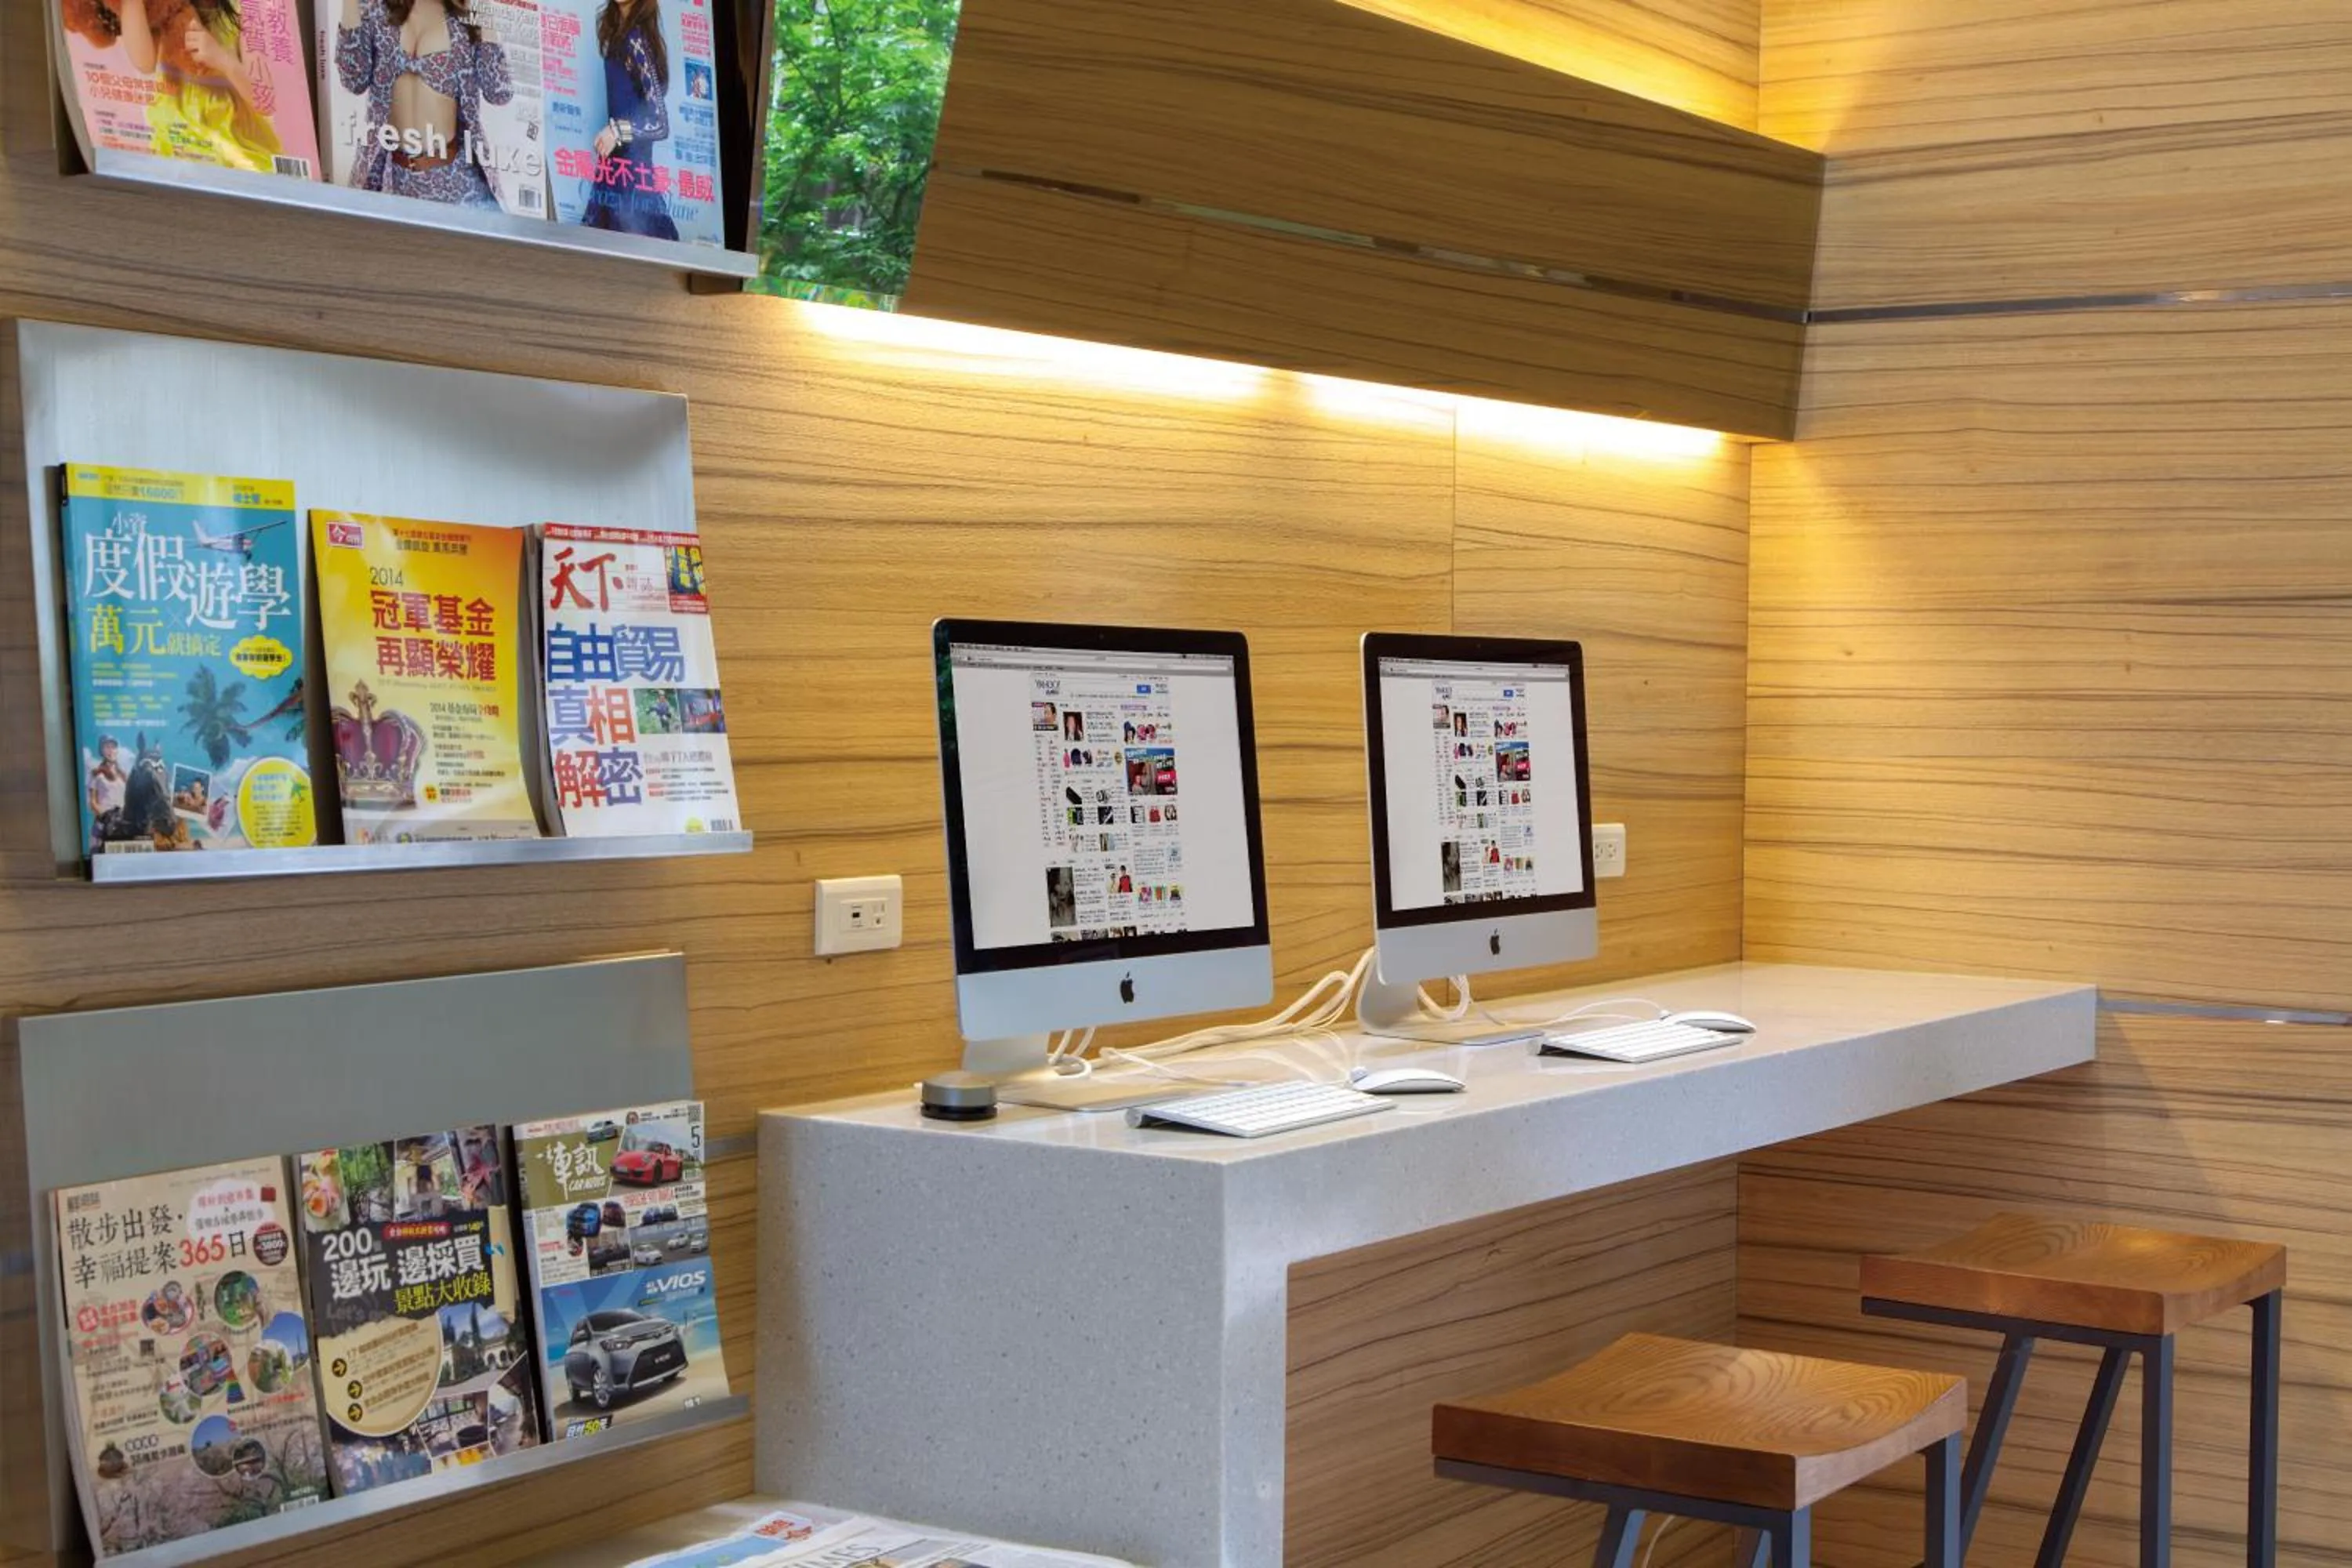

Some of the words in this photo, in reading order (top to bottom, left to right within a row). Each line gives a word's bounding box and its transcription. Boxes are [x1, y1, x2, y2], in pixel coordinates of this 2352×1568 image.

[342, 109, 448, 160] fresh
[85, 528, 292, 630] 度假遊學
[369, 566, 405, 586] 2014
[370, 590, 495, 637] 冠軍基金
[375, 636, 496, 681] 再顯榮耀
[546, 622, 686, 683] 自由貿易
[548, 685, 637, 746] 真相
[554, 746, 644, 808] 解密
[690, 1124, 701, 1149] 5
[656, 1269, 706, 1293] VIOS
